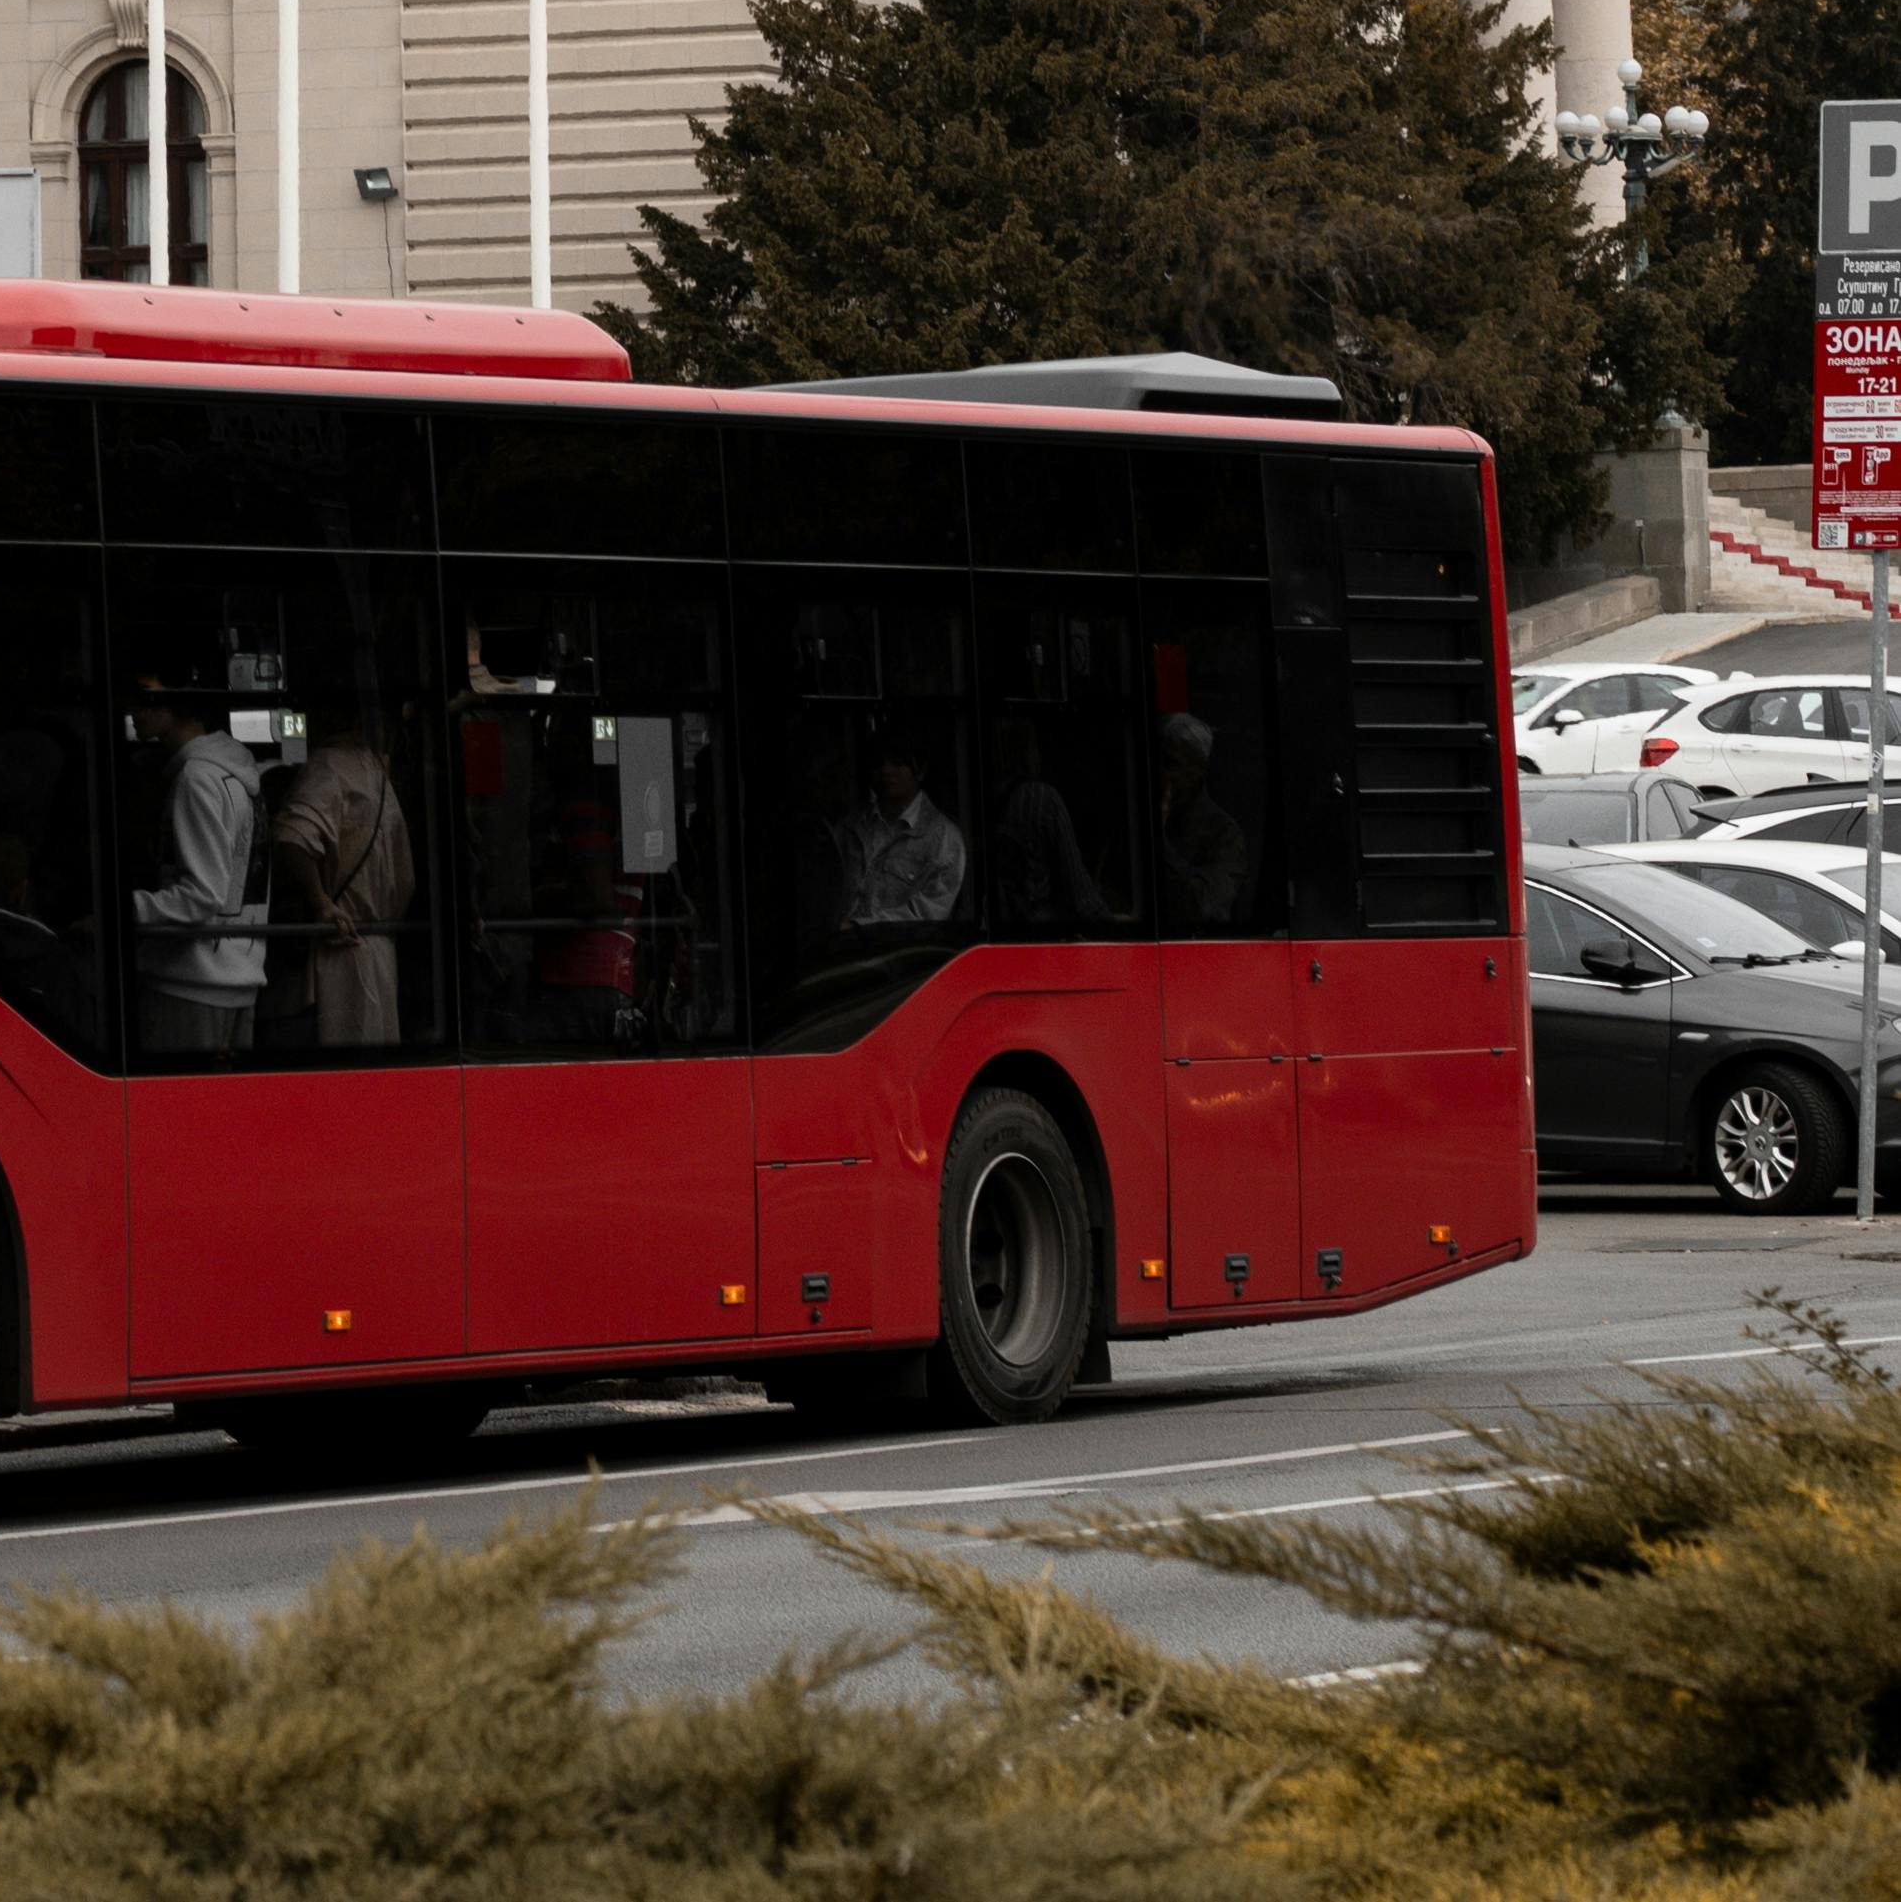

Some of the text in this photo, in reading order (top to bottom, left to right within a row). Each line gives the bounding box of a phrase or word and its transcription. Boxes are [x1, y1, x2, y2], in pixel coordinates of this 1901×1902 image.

[1849, 120, 1901, 234] P
[1838, 277, 1888, 298] Скупштину
[1818, 302, 1832, 315] од
[1838, 298, 1865, 315] 07.00
[1870, 302, 1883, 315] до
[1825, 326, 1901, 354] ЗОНА
[1858, 377, 1897, 394] 17-21
